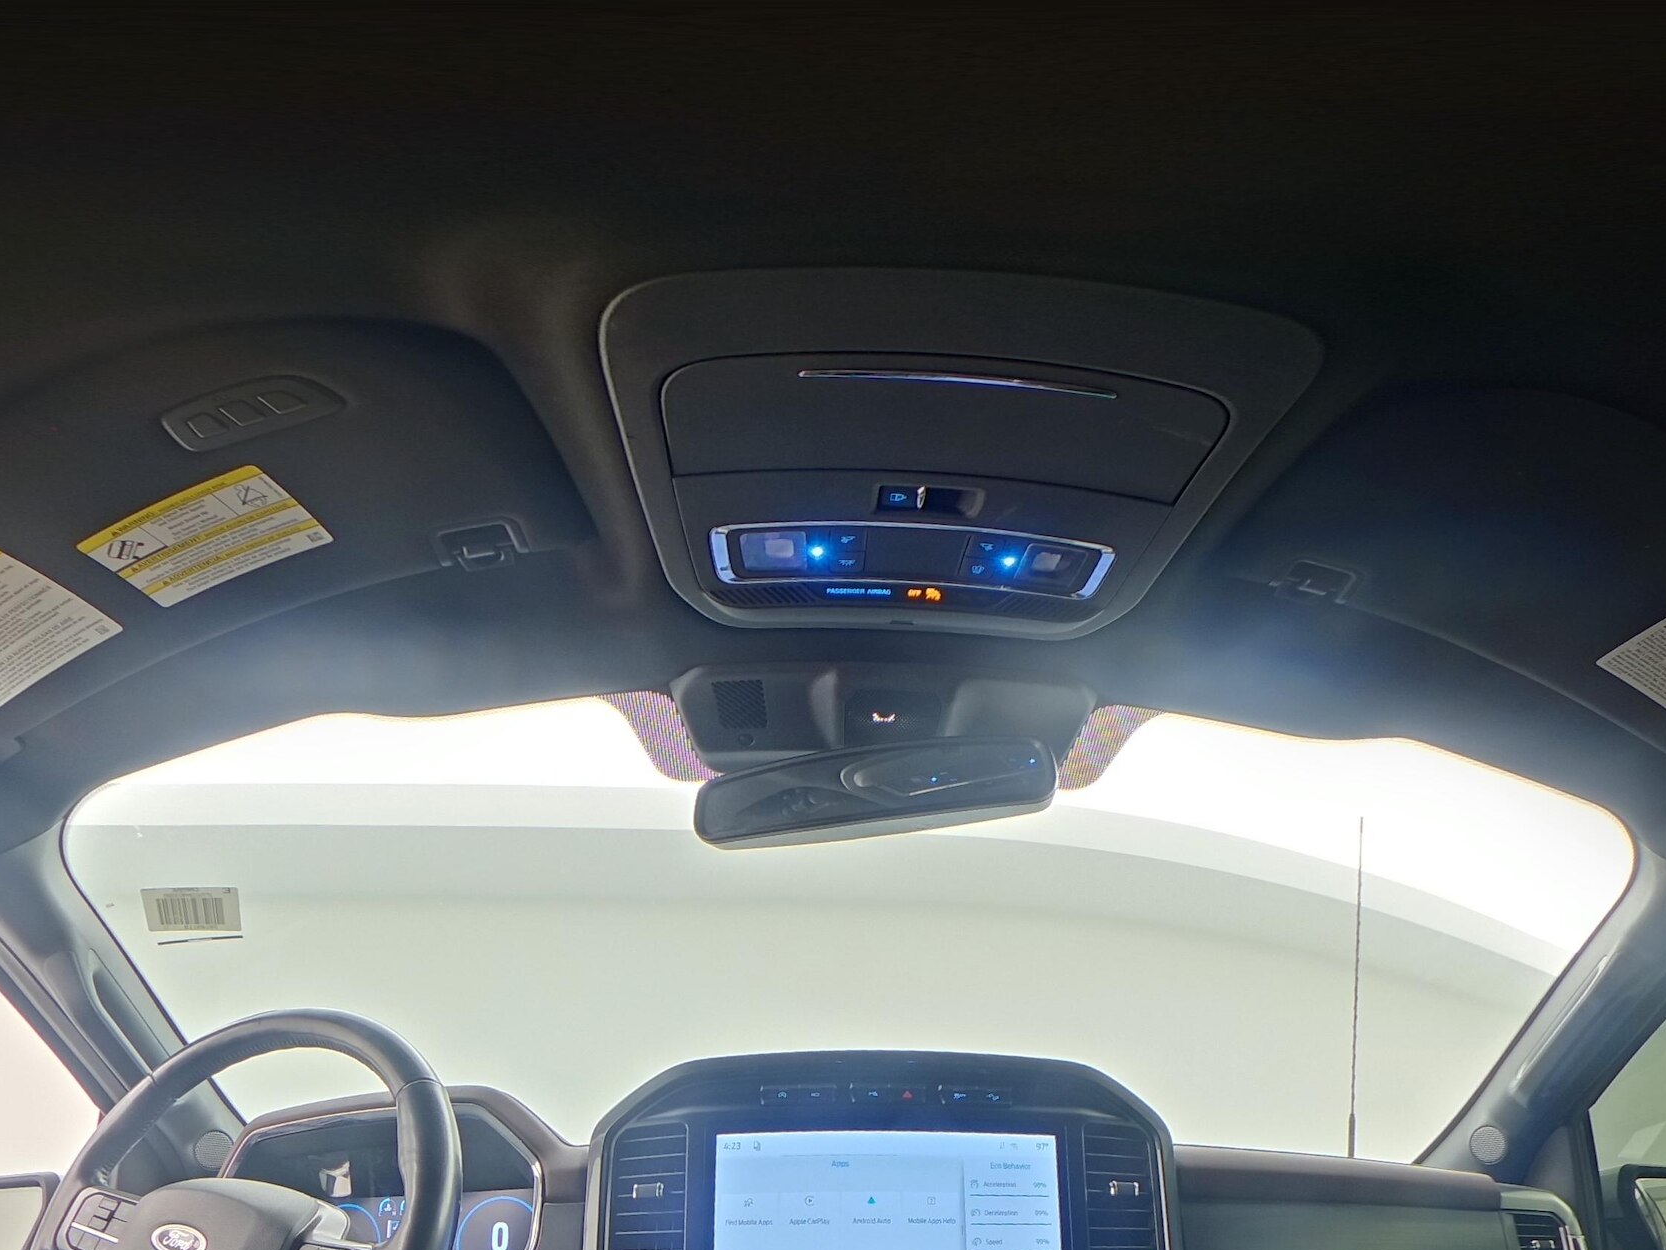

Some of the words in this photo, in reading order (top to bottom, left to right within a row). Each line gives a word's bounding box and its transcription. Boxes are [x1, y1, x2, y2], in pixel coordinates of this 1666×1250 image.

[723, 1141, 741, 1150] 4:23
[831, 1159, 850, 1168] Apps
[163, 1230, 195, 1250] Ford
[985, 1237, 1003, 1246] Speed
